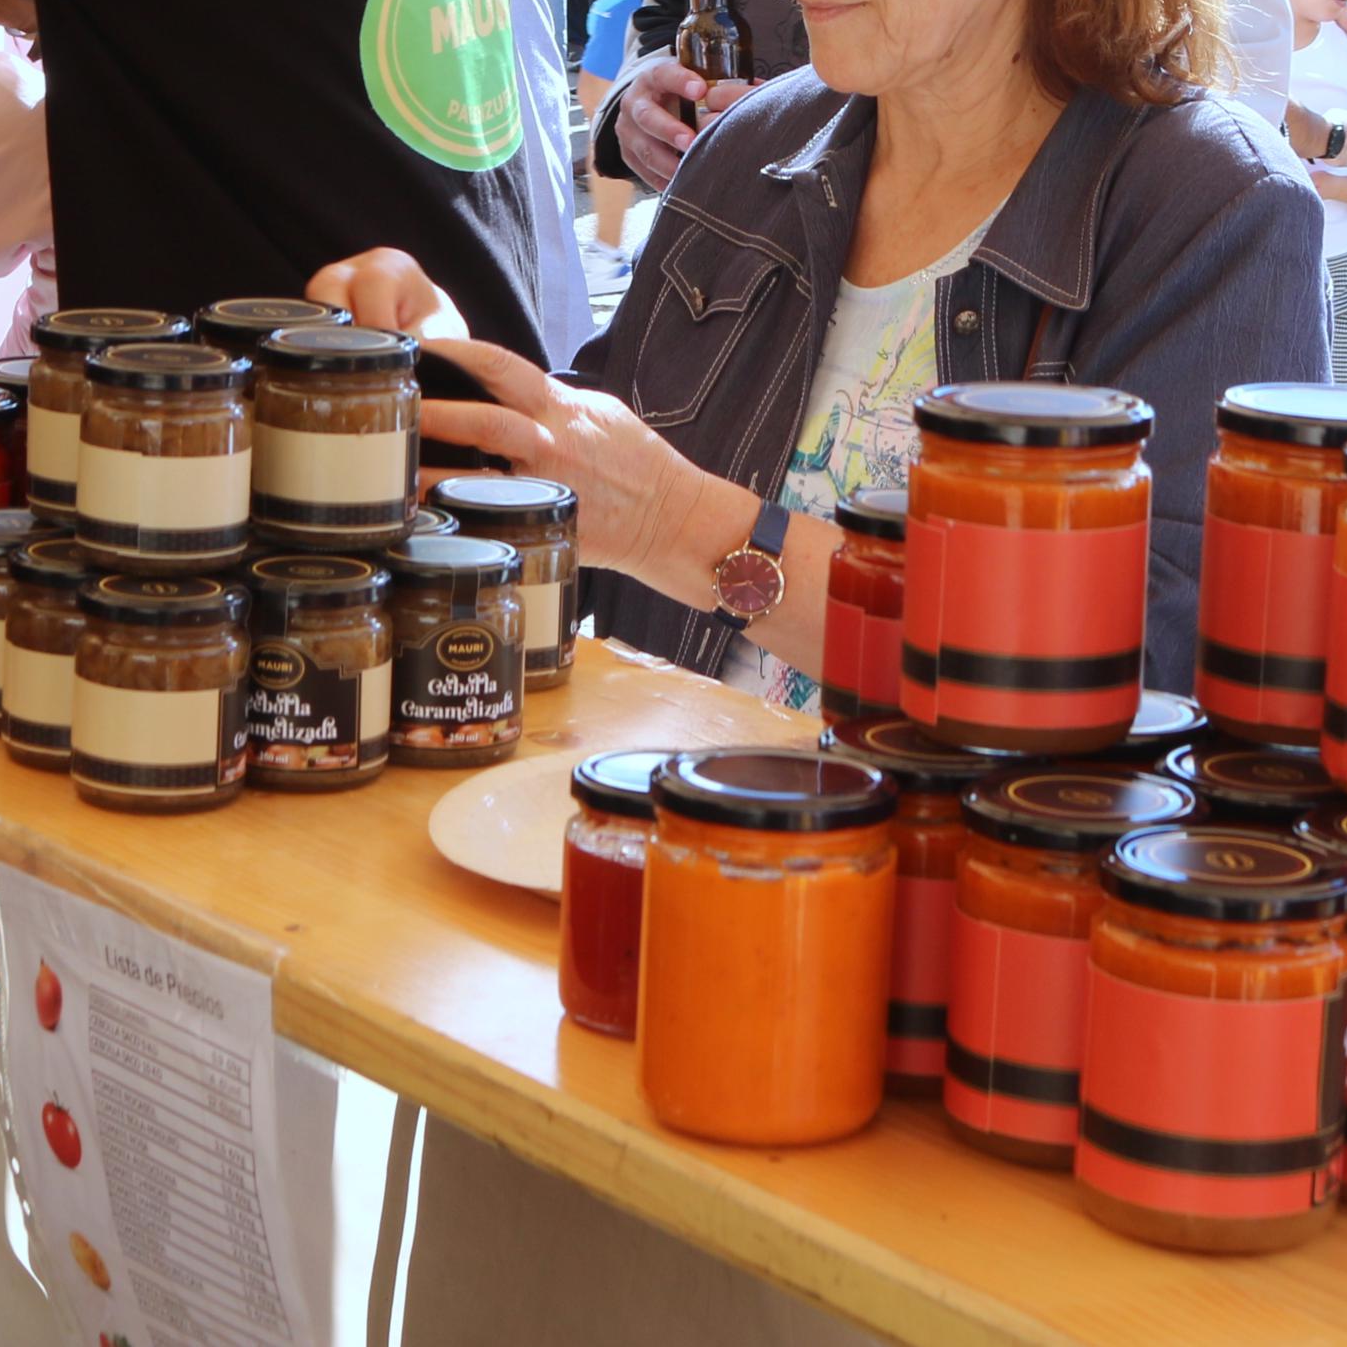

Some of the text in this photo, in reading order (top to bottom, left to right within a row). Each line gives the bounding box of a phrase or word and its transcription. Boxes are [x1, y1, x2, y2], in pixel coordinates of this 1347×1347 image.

[448, 643, 484, 654] MAURI
[258, 660, 293, 673] MAURI
[428, 672, 497, 697] Cebolla
[401, 691, 514, 722] Caramelizada
[104, 946, 140, 981] Lista
[144, 966, 163, 992] de
[166, 972, 224, 1021] Precios
